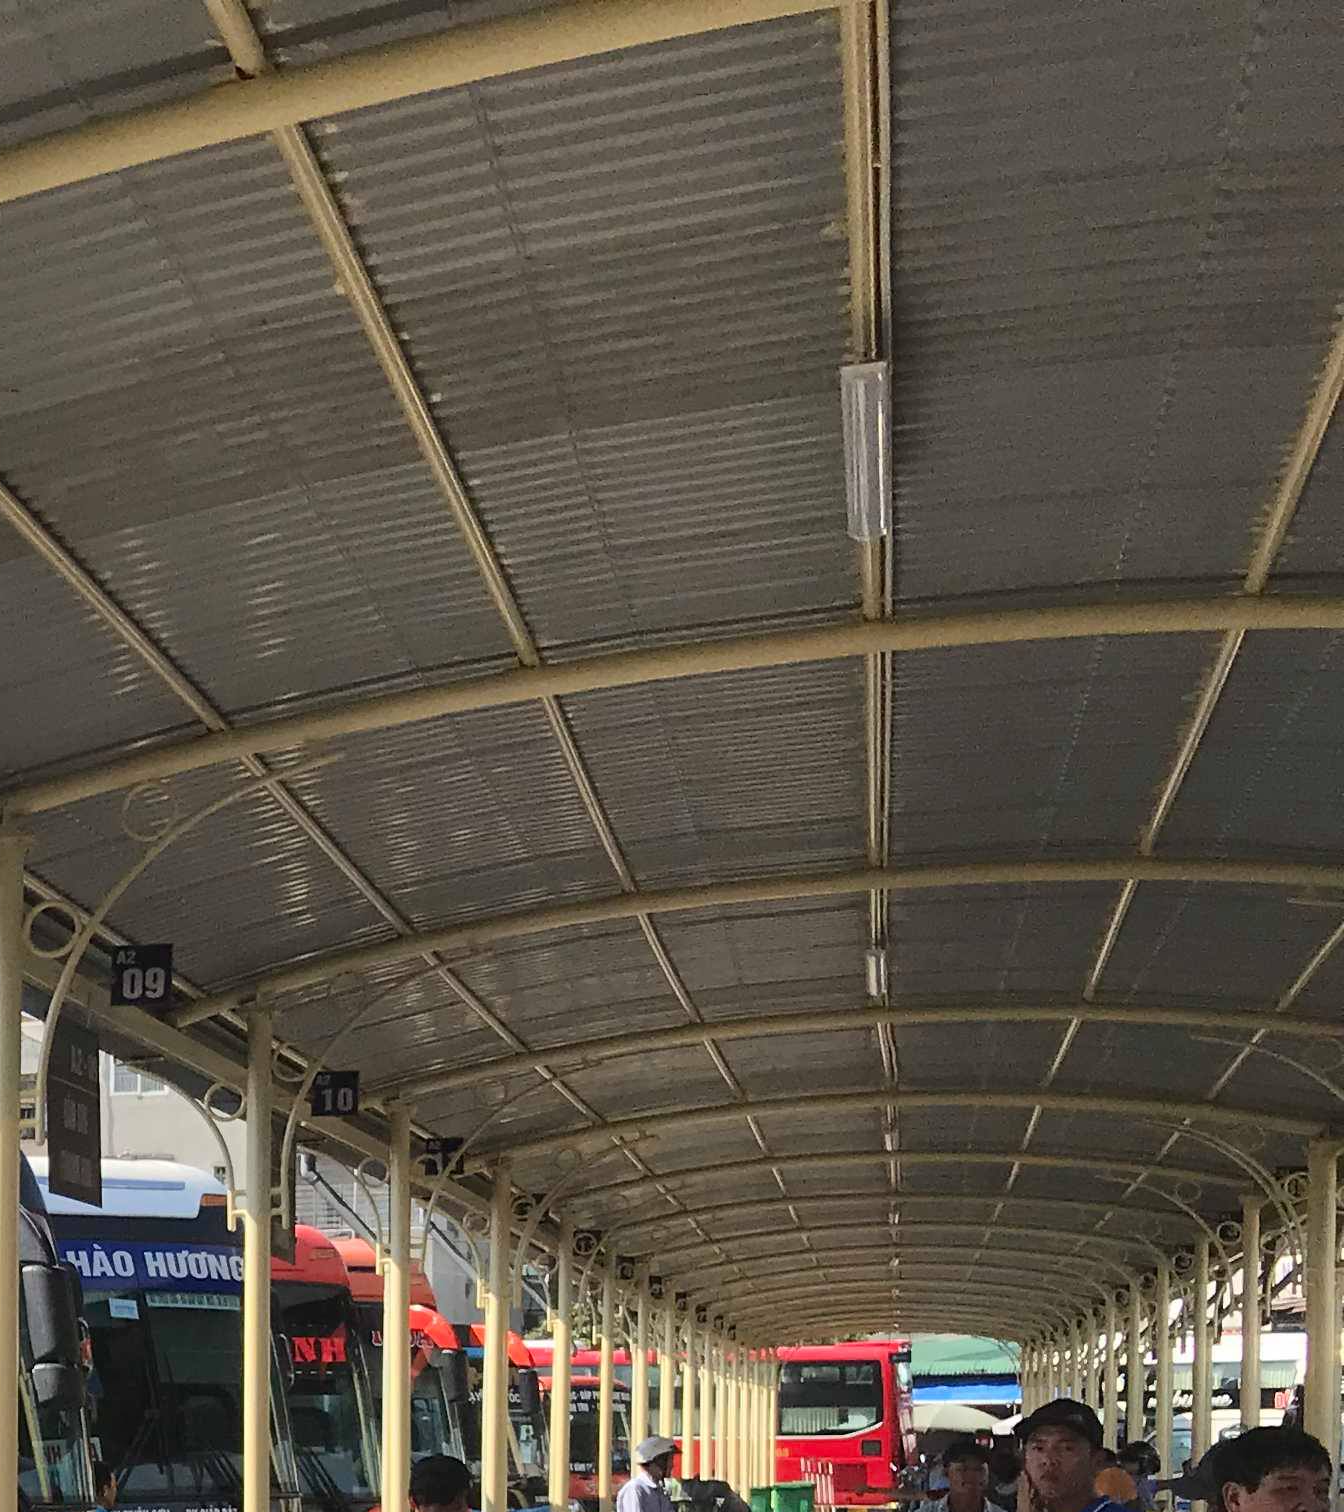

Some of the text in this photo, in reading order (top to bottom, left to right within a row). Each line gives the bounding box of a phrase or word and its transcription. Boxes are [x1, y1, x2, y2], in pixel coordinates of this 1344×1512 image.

[116, 950, 137, 965] A2
[123, 967, 165, 999] 09
[321, 1088, 354, 1111] 10
